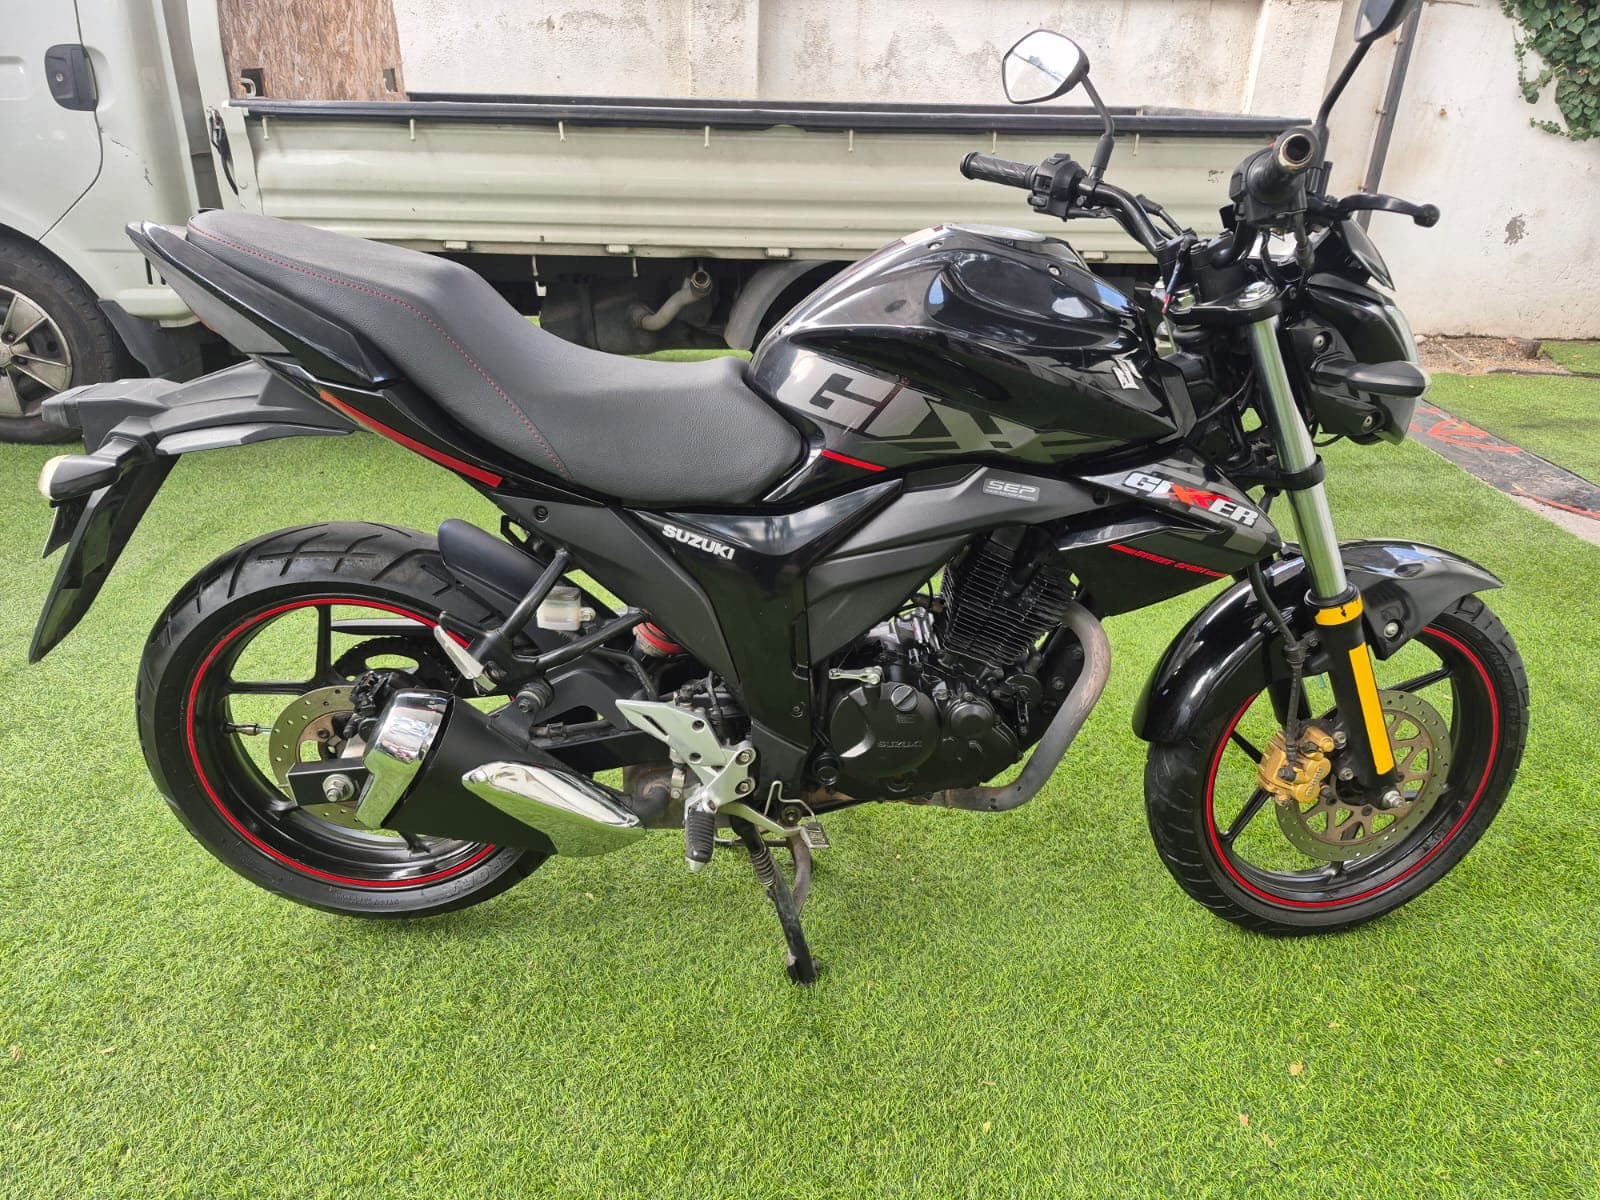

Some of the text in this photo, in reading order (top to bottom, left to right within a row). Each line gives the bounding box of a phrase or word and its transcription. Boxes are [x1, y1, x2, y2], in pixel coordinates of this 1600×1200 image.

[986, 480, 1037, 494] SEP
[1122, 471, 1260, 528] GIXXER
[662, 523, 736, 560] SUZUKI
